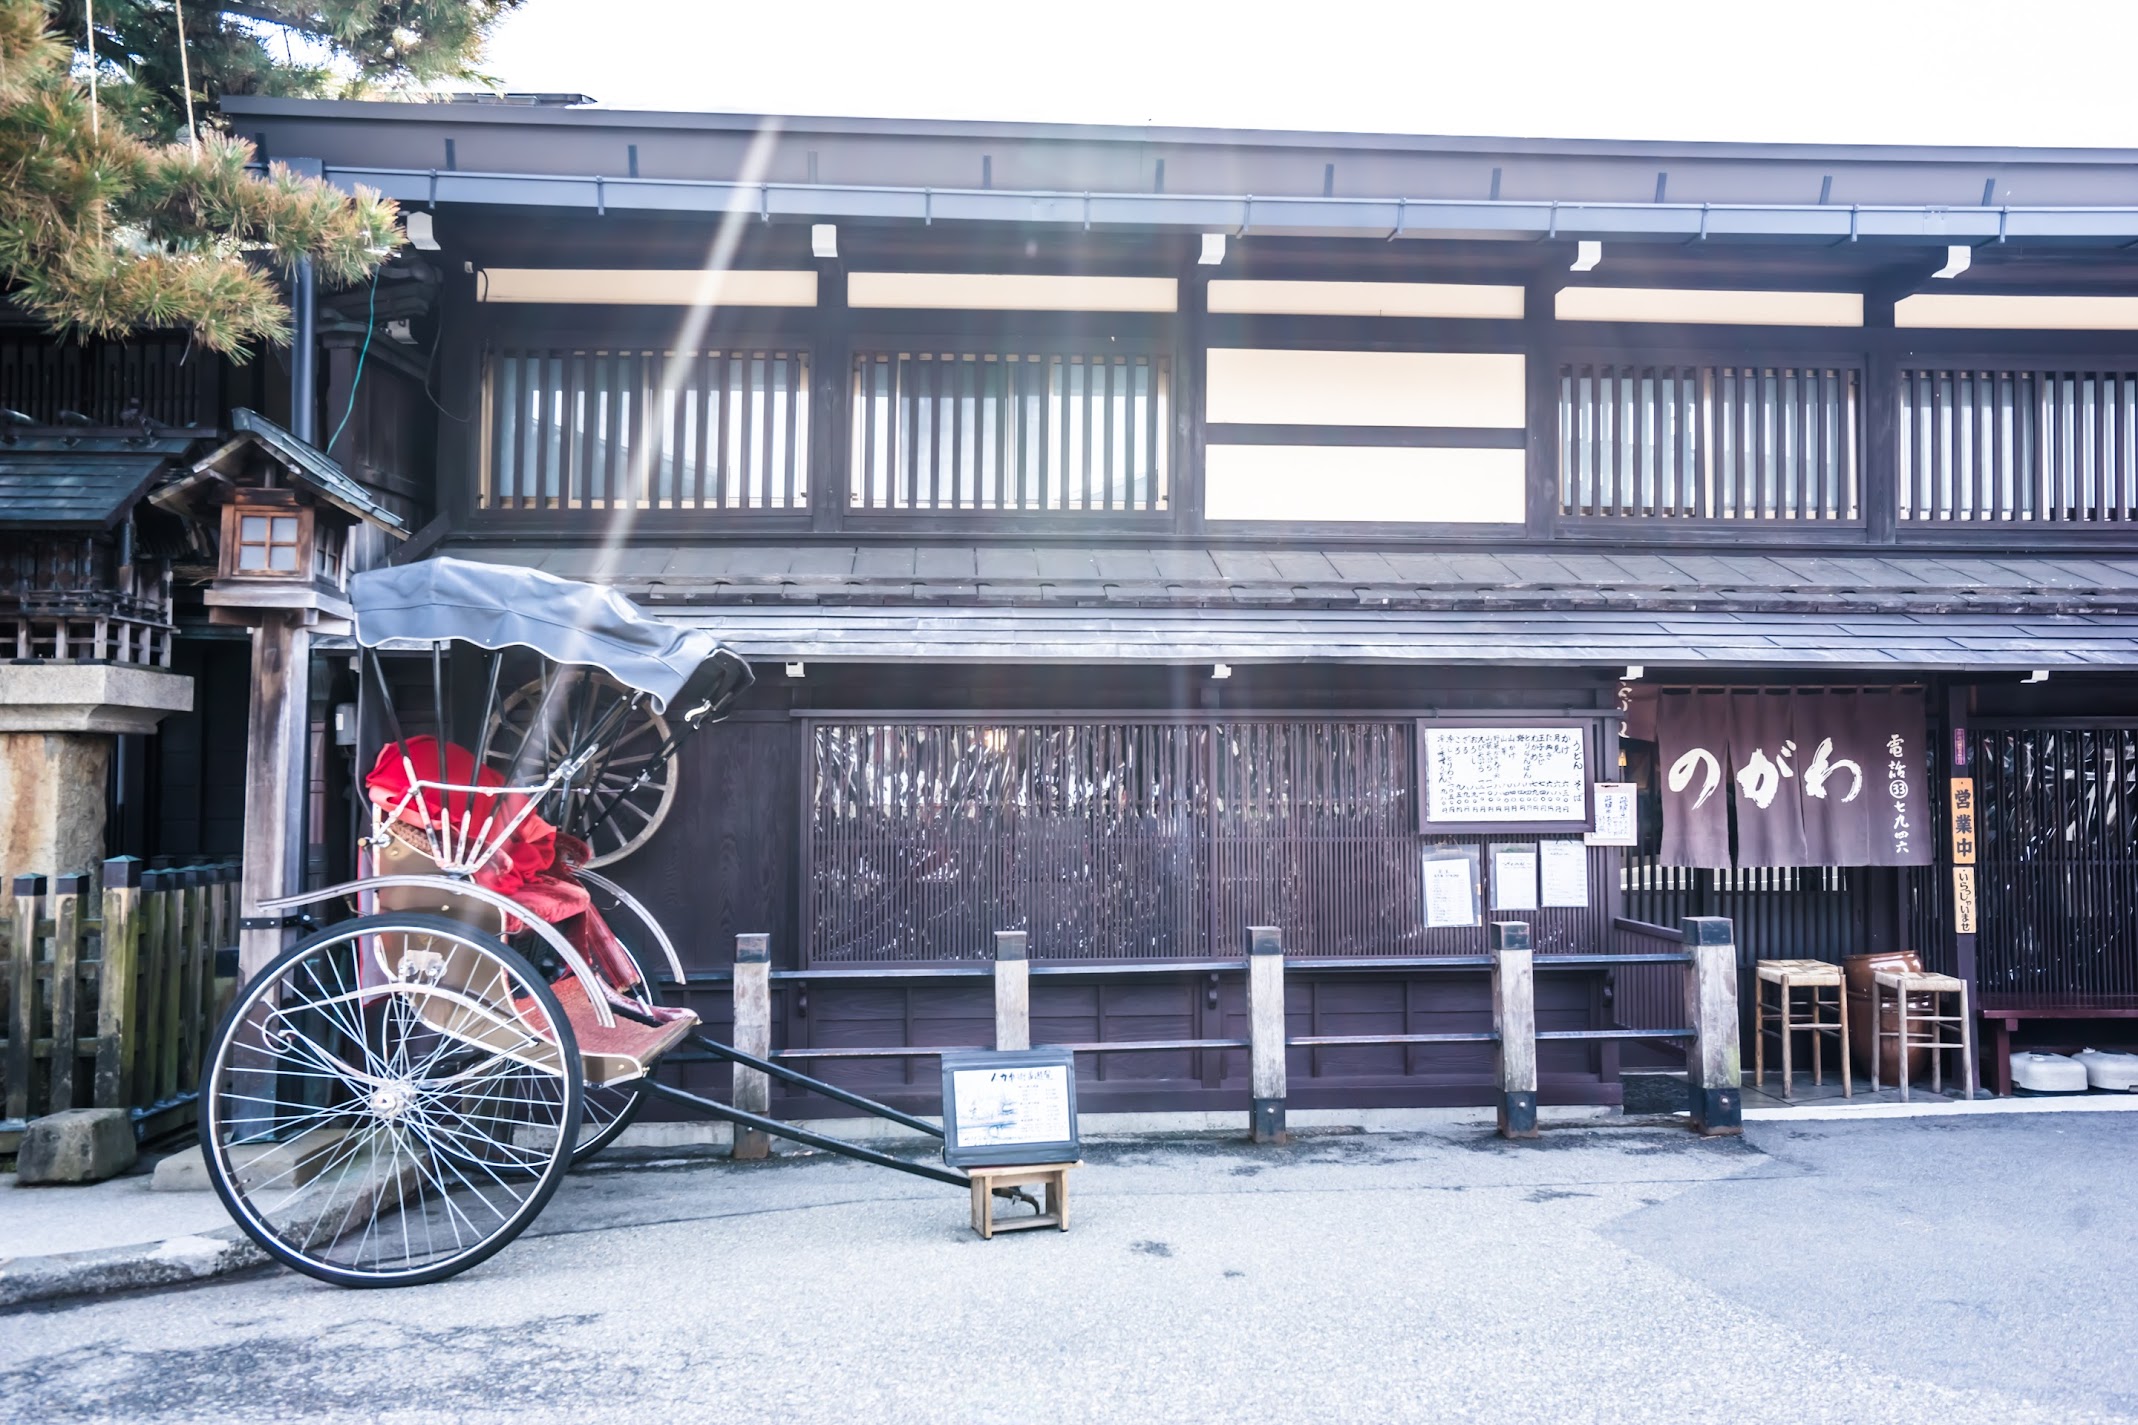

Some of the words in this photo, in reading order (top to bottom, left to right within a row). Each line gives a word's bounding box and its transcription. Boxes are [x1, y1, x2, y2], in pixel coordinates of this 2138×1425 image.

[1561, 734, 1571, 755] かけ
[1668, 737, 1863, 809] のがわ
[1954, 788, 1973, 857] 営業中
[1958, 872, 1972, 932] いらっしゃいませ
